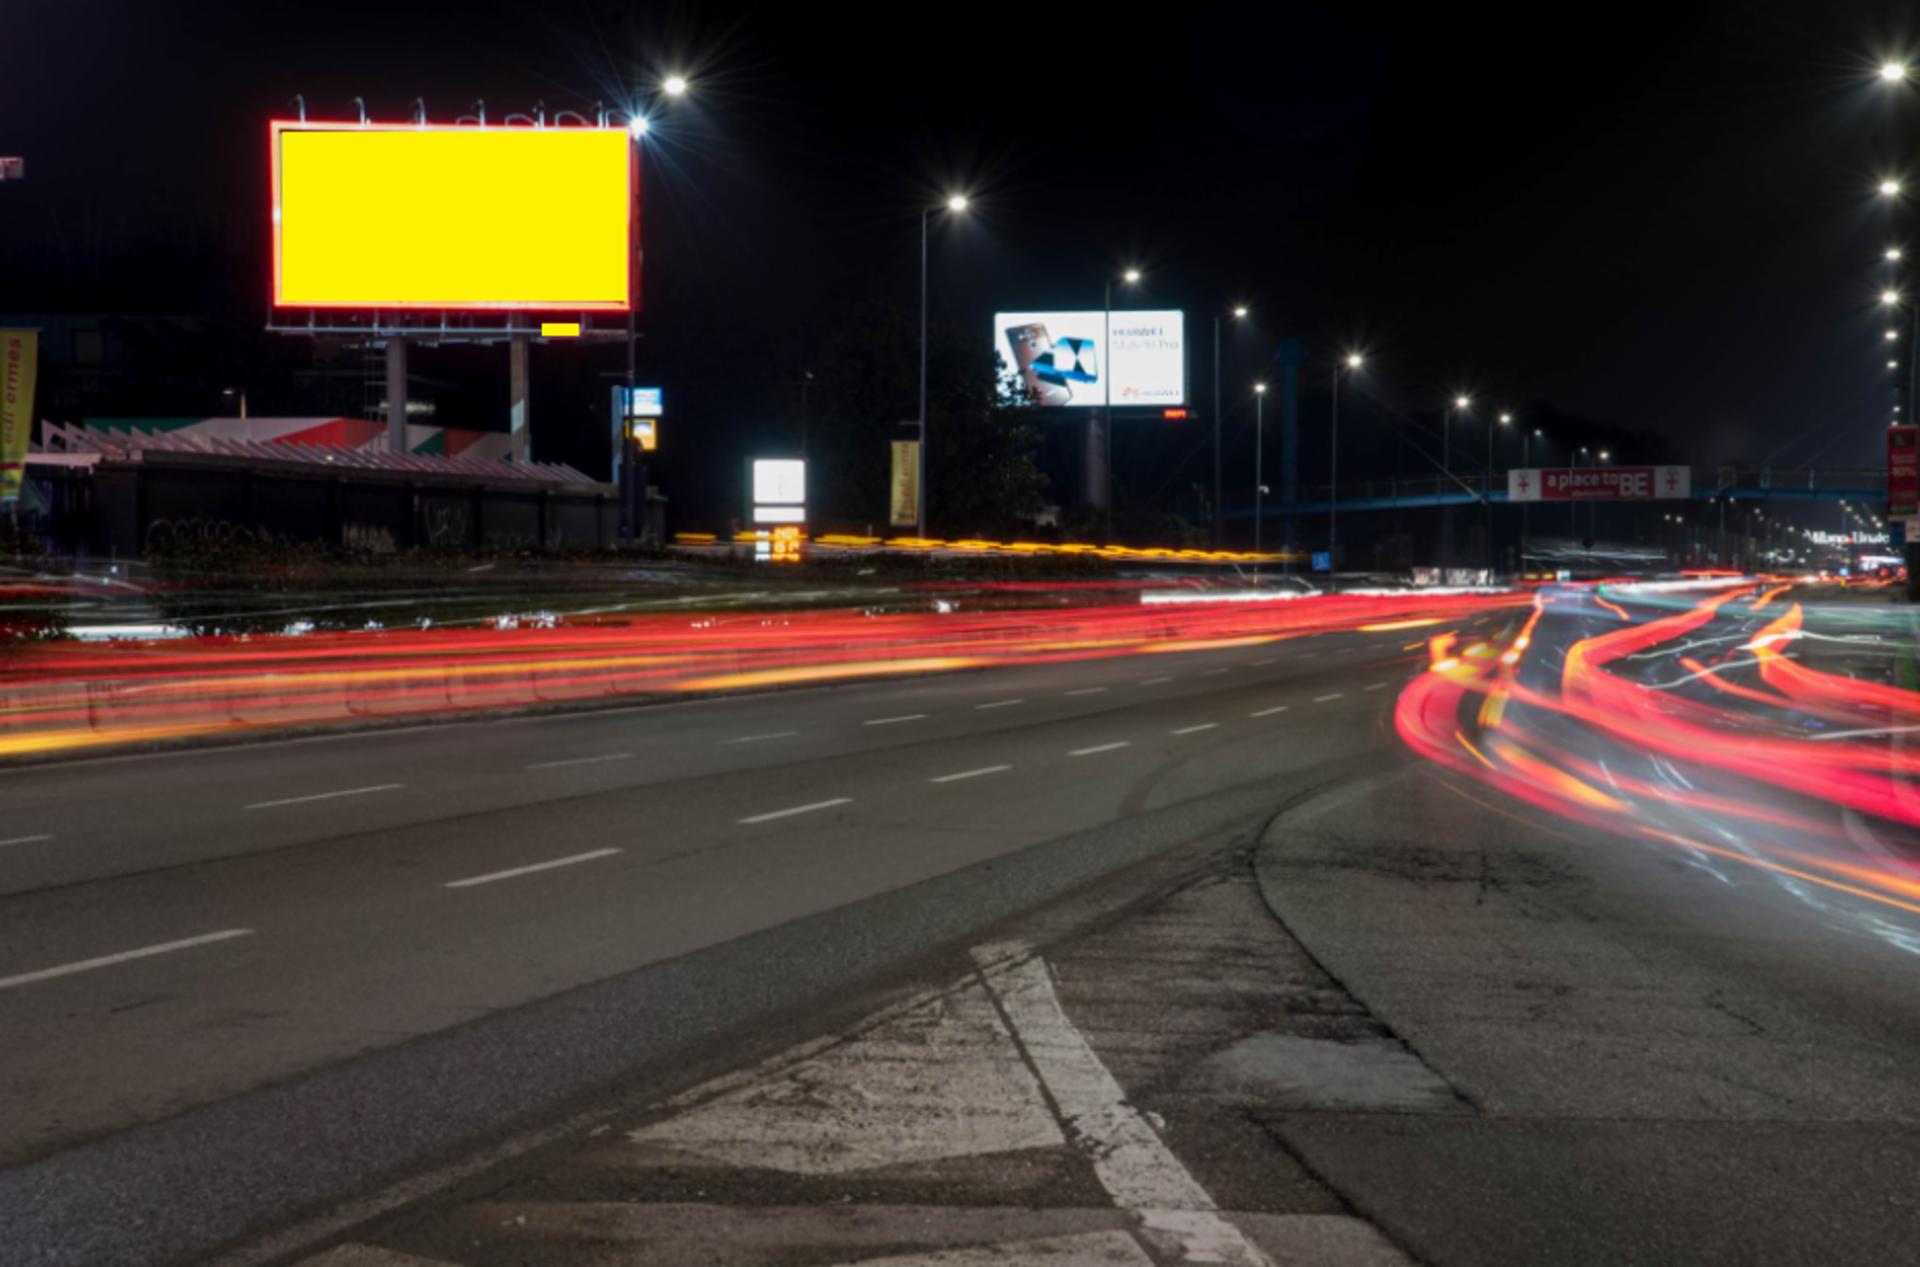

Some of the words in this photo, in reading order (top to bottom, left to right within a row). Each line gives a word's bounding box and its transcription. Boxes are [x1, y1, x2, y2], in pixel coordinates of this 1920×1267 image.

[1547, 475, 1557, 487] a
[1559, 470, 1599, 491] place
[1602, 472, 1618, 486] to
[1619, 473, 1649, 496] BE
